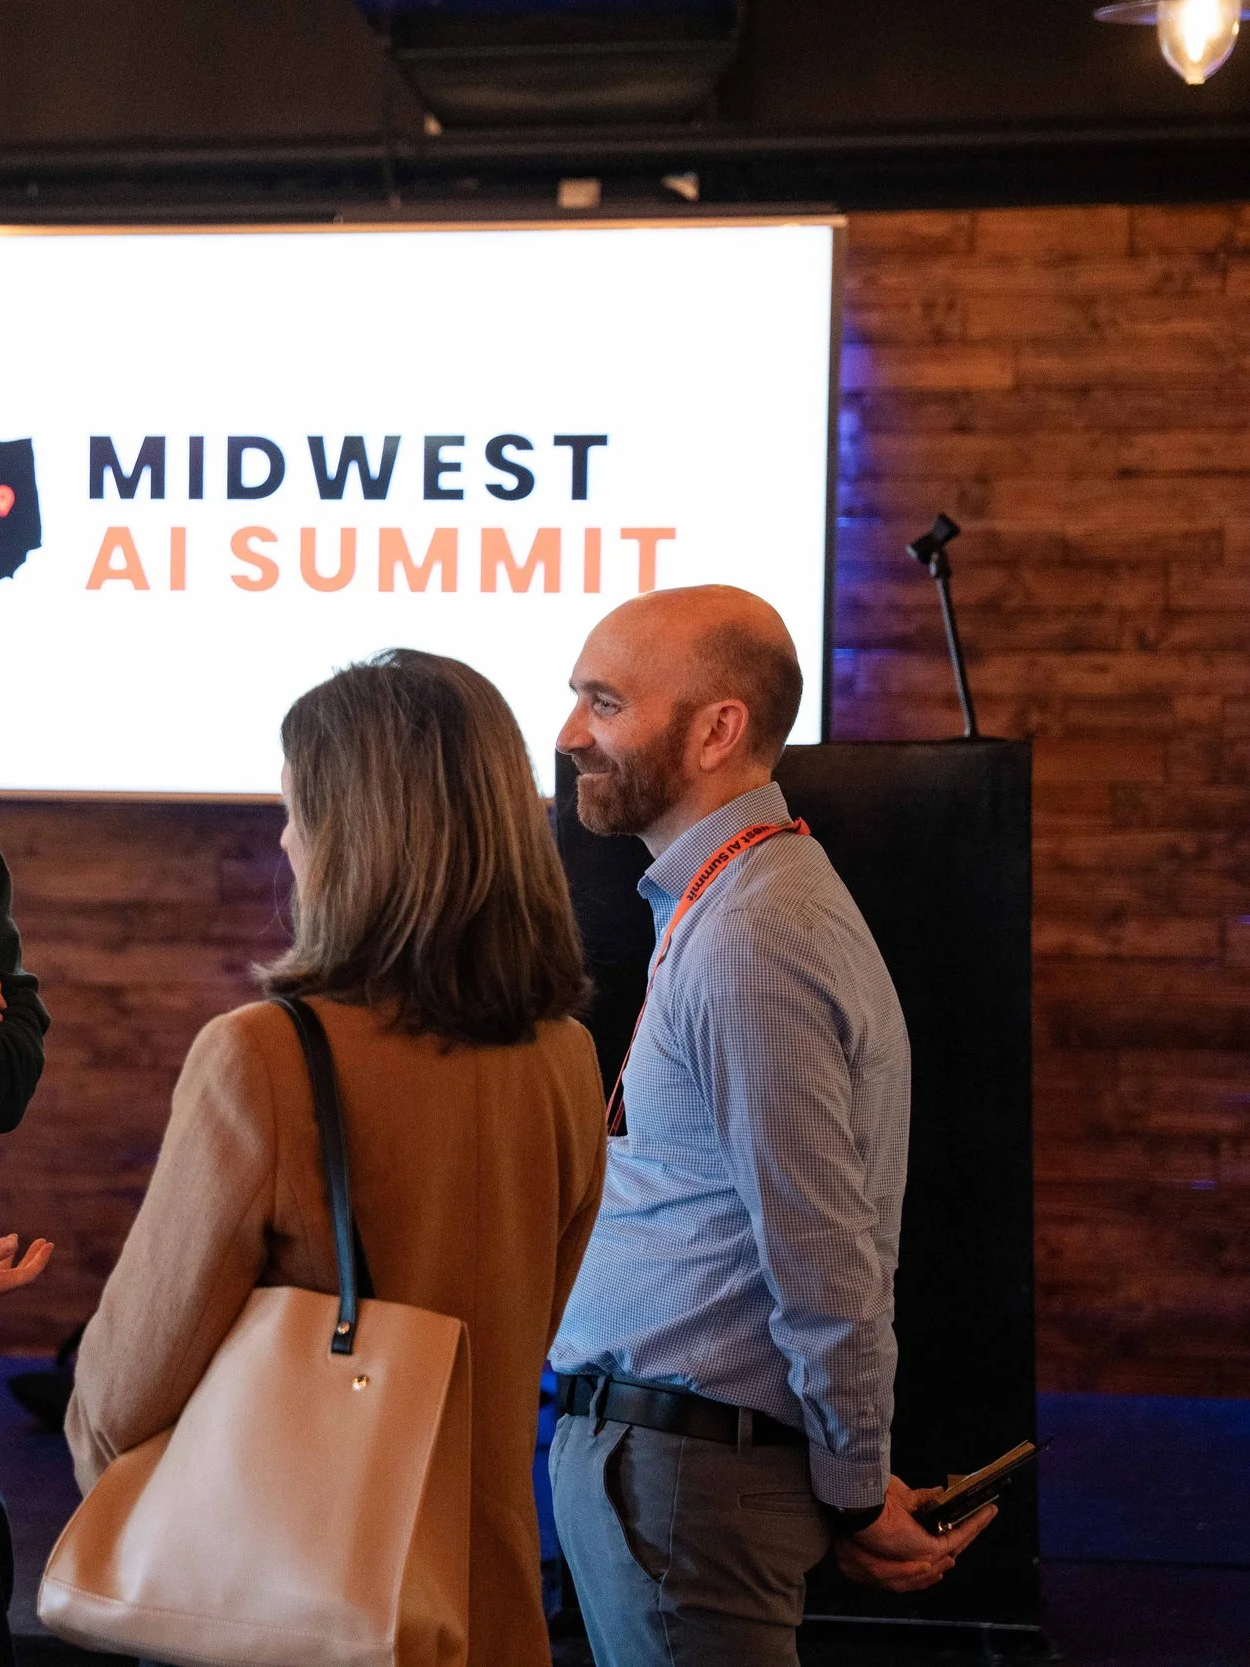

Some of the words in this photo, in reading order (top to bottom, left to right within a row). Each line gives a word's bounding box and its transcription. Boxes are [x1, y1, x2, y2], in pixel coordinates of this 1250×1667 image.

[88, 433, 608, 501] MIDWEST
[85, 526, 186, 592] AI
[229, 525, 676, 594] SUMMIT
[686, 852, 730, 901] Summit
[726, 840, 741, 855] AI
